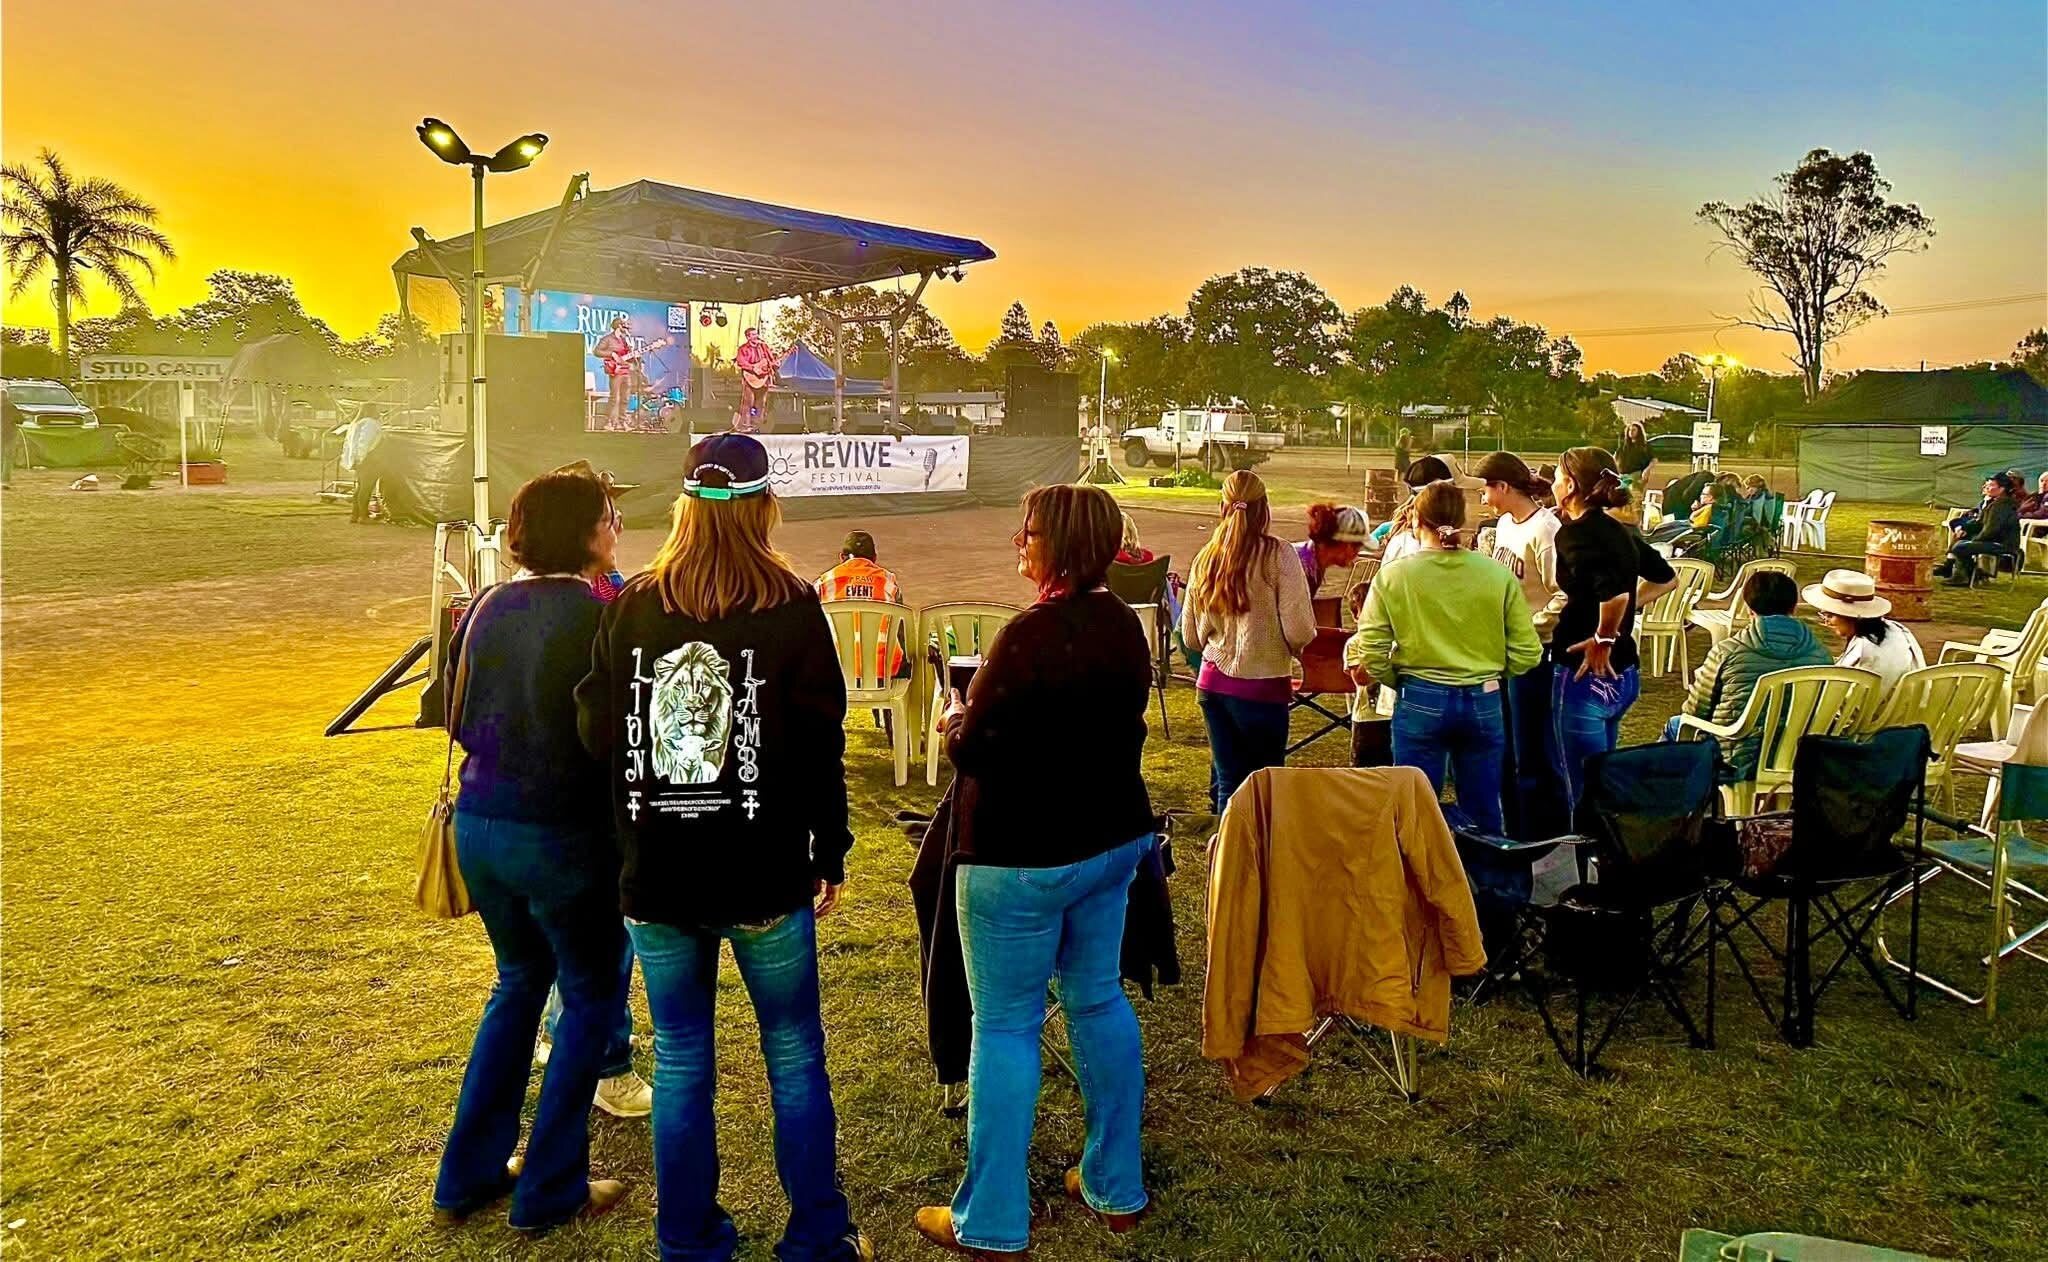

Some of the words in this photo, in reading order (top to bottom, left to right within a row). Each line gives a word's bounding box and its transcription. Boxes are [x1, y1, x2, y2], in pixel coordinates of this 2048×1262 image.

[90, 361, 149, 374] STUD
[156, 362, 225, 376] CATTL
[804, 441, 891, 469] REVIVE
[811, 472, 882, 483] FESTIVAL
[846, 586, 874, 598] EVENT
[624, 647, 654, 783] LION
[734, 649, 766, 783] LAMB
